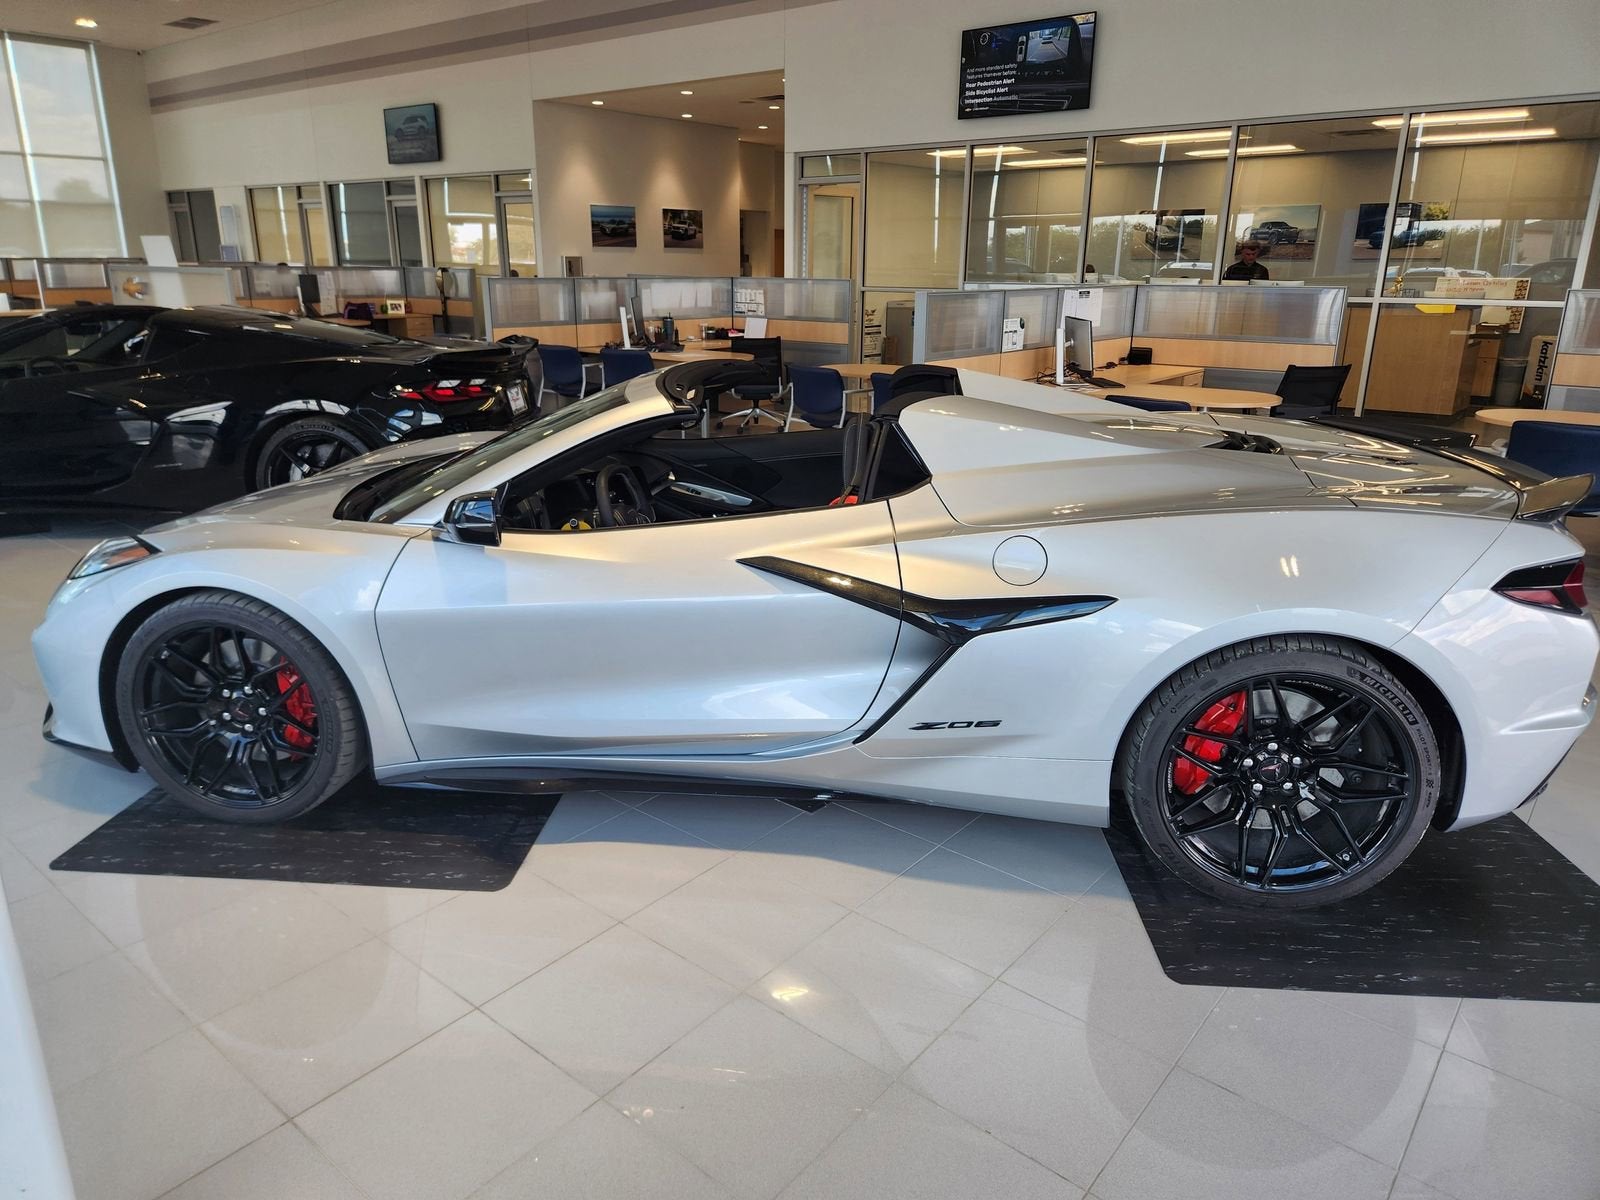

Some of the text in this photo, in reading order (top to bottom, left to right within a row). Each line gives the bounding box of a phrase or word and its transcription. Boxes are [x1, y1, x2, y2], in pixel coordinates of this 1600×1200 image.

[1535, 340, 1553, 382] katzkin
[1363, 675, 1418, 724] MICHELIN
[908, 720, 1002, 730] Z06
